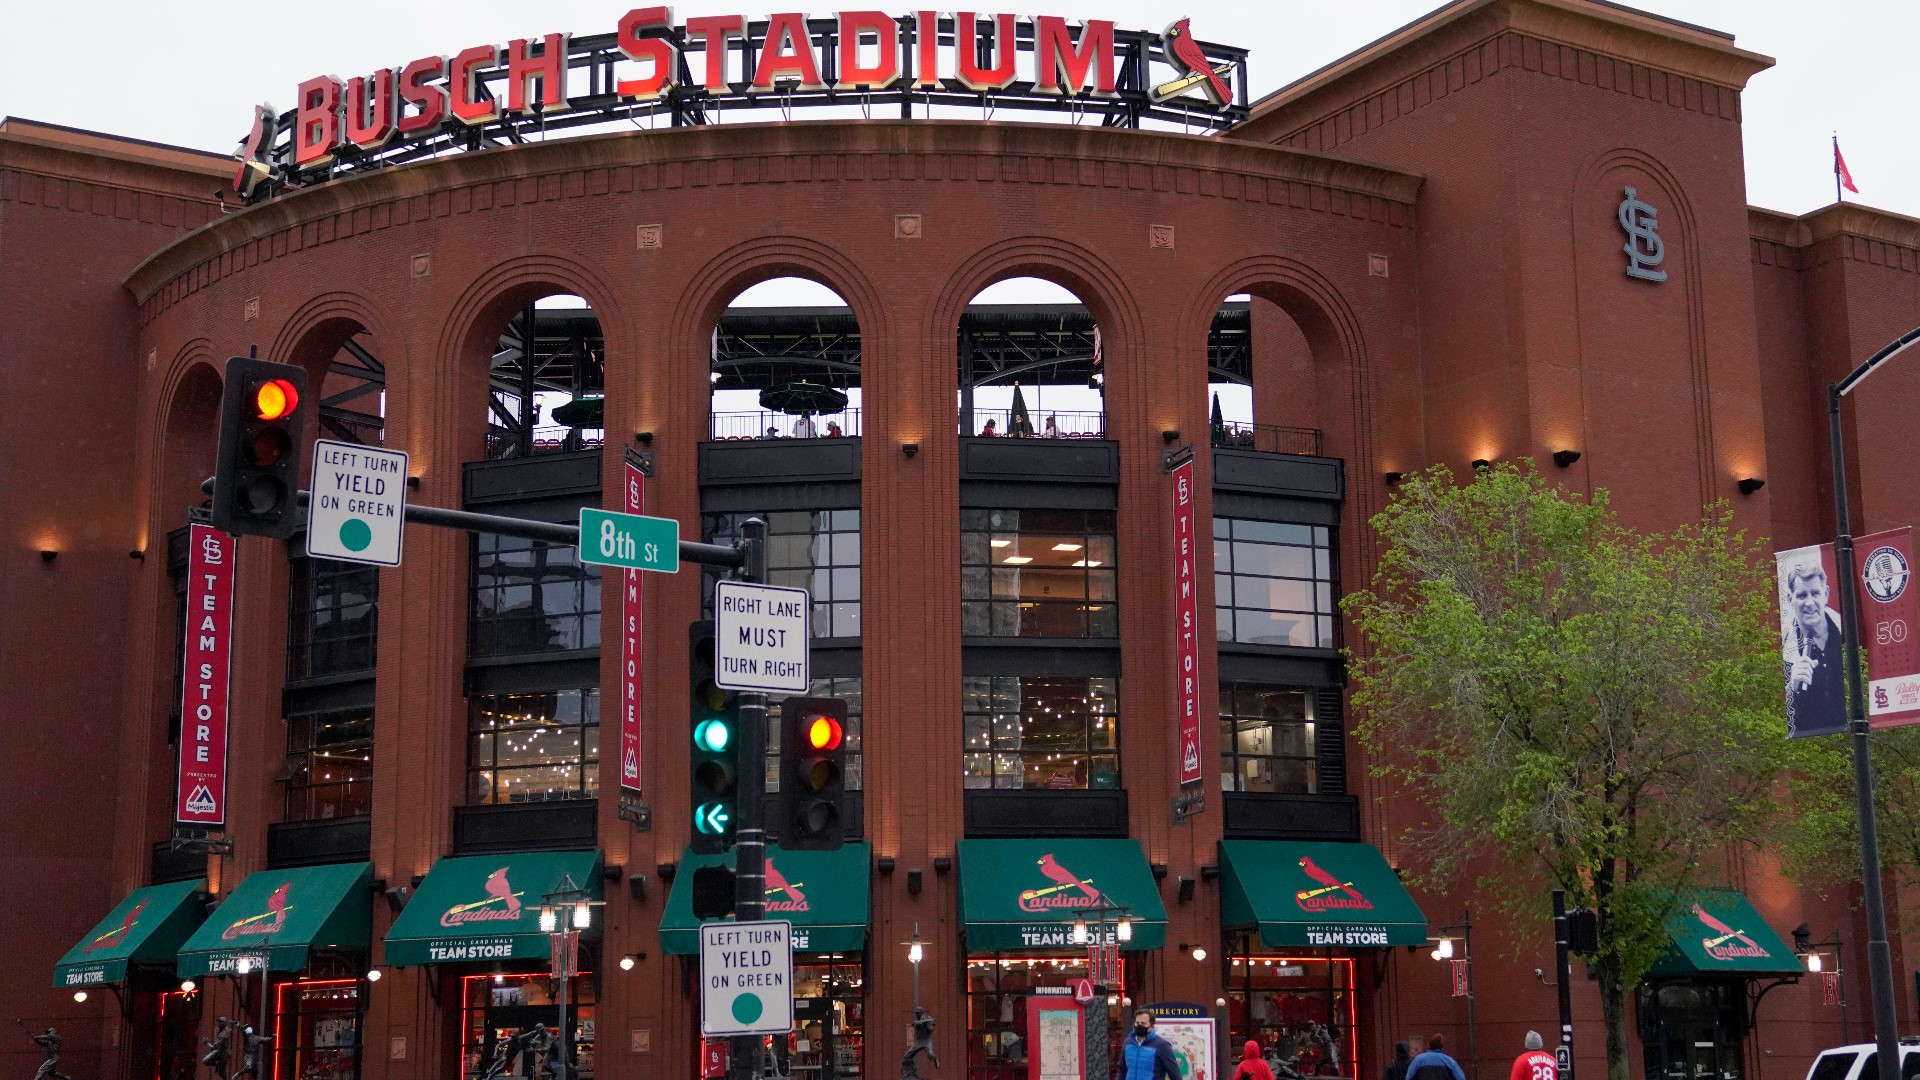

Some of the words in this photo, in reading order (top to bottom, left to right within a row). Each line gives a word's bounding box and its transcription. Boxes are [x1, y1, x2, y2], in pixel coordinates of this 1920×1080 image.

[296, 32, 573, 170] BUSCH
[617, 6, 1122, 100] STADIUM
[325, 450, 357, 467] LEFT
[364, 456, 398, 474] TURN
[335, 472, 385, 496] YIELD
[321, 495, 340, 510] ON
[348, 499, 395, 517] GREEN
[600, 519, 636, 560] 8th
[644, 543, 658, 563] St
[1181, 515, 1190, 599] TEAM
[629, 568, 637, 604] AM
[199, 574, 217, 652] TEAM
[724, 596, 762, 615] RIGHT
[768, 600, 802, 618] LANE
[739, 626, 786, 648] MUST
[1877, 619, 1907, 645] 50
[628, 615, 636, 723] STORE
[723, 657, 757, 674] TURN
[765, 660, 802, 678] RIGHT
[1183, 610, 1193, 716] STORE
[195, 663, 212, 763] STORE
[187, 803, 214, 811] Majestic
[765, 898, 810, 912] inals
[1296, 889, 1374, 912] Cardinals
[441, 904, 521, 927] Cardinals
[710, 932, 741, 946] LEFT
[748, 930, 781, 944] TURN
[1021, 933, 1064, 945] TEAM
[1307, 932, 1343, 944] TEAM
[1345, 932, 1388, 945] STORE
[430, 947, 467, 960] TEAM
[468, 945, 513, 958] STORE
[722, 950, 771, 968] YIELD
[1703, 938, 1771, 961] Cardinals
[208, 960, 235, 972] TEAM
[66, 973, 83, 985] TEAM
[84, 971, 104, 983] STORE
[712, 975, 729, 989] ON
[738, 973, 782, 988] GREEN
[1035, 986, 1072, 995] INFORMATION
[1149, 1008, 1200, 1016] DIRECTORY
[1532, 1065, 1553, 1080] 28
